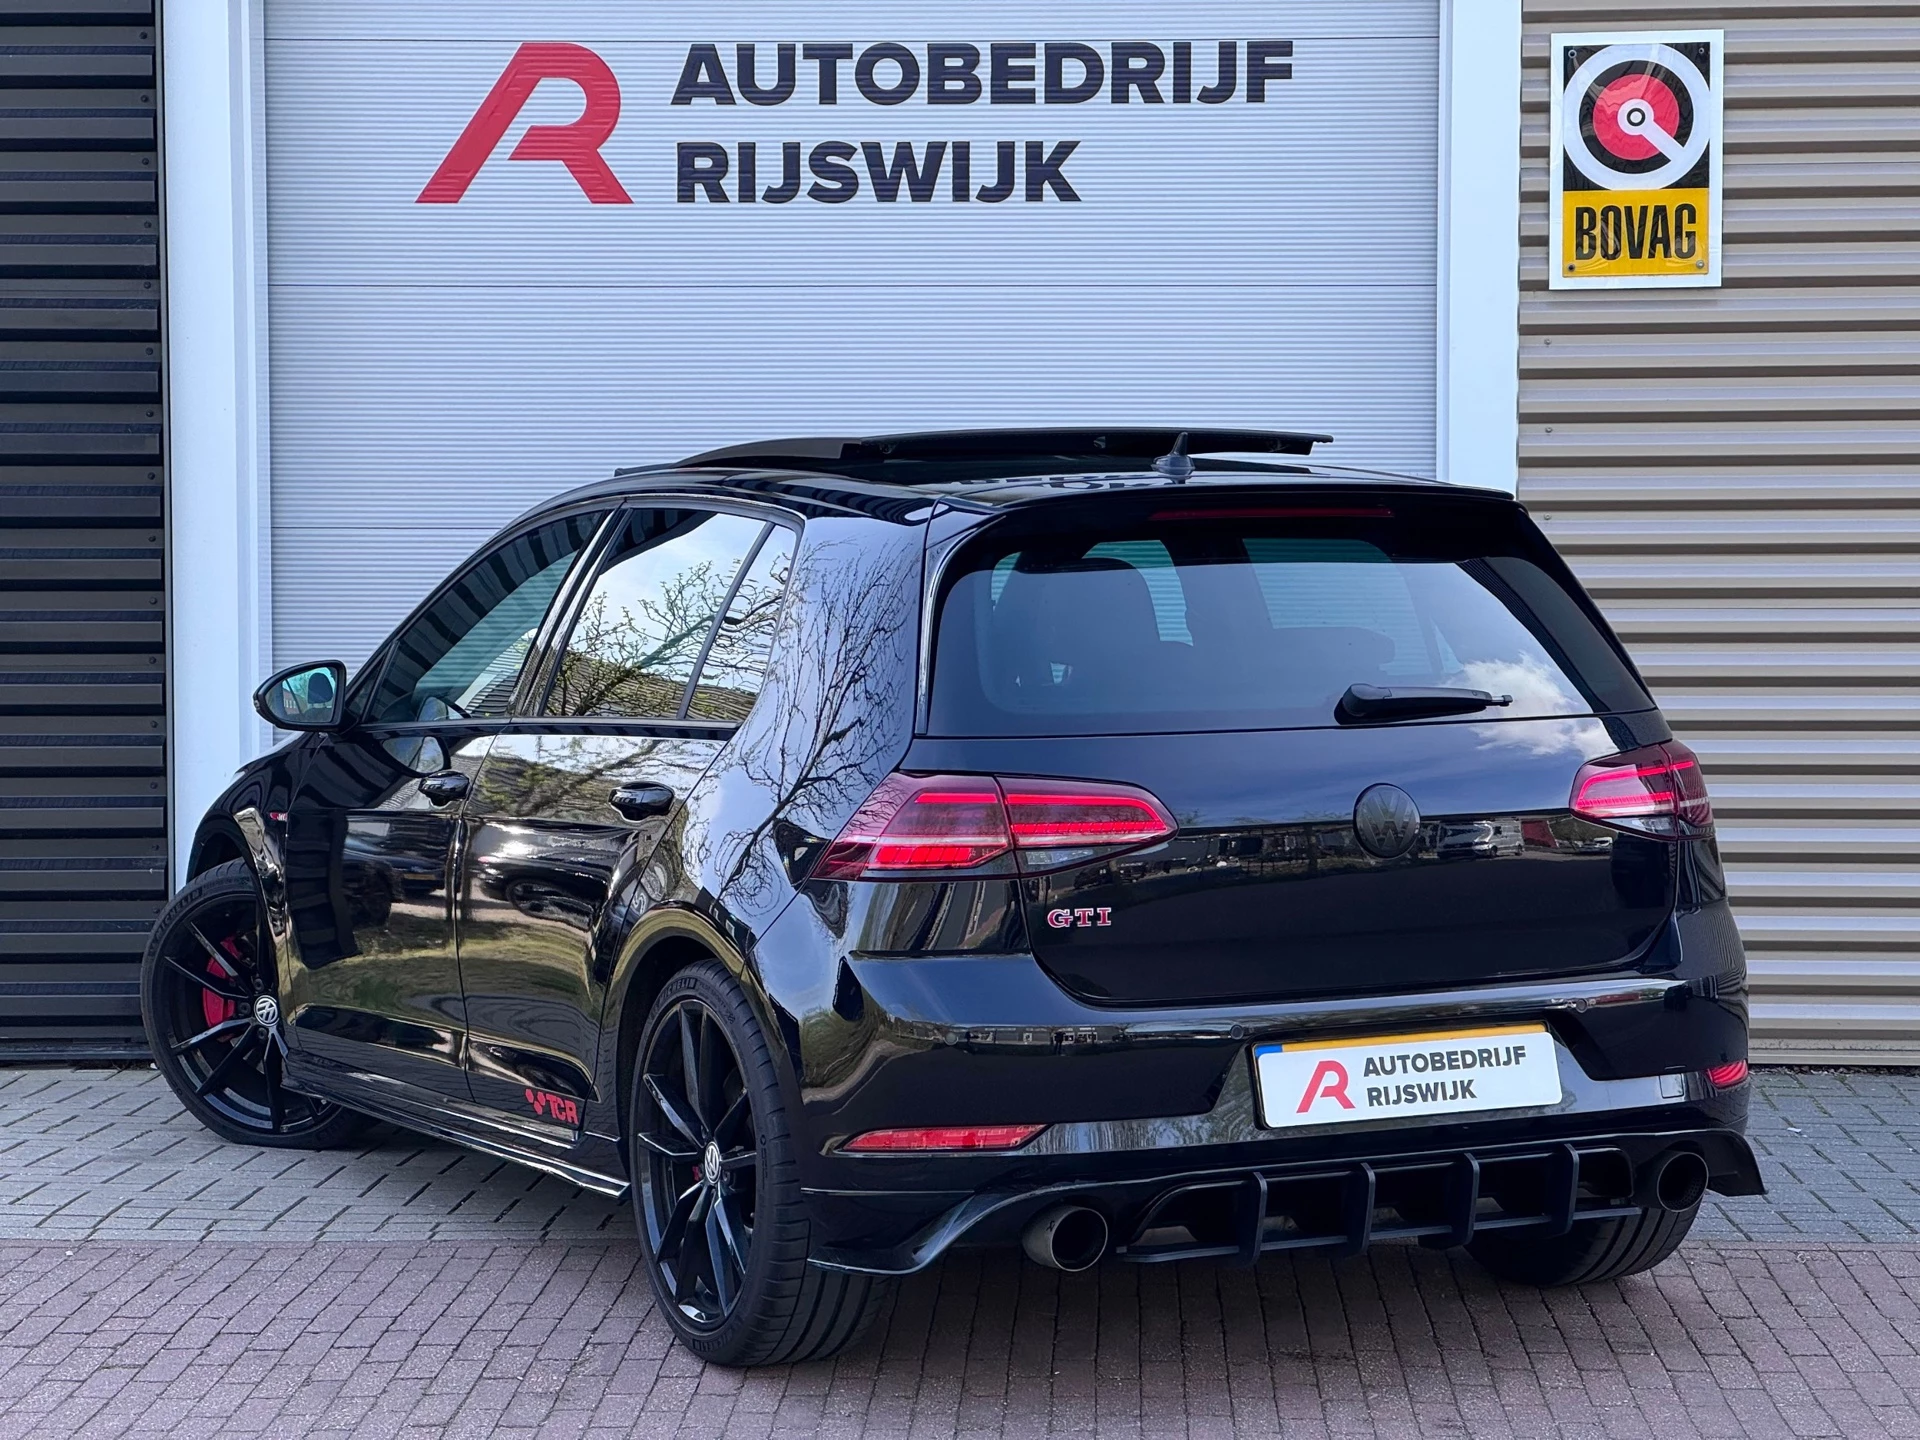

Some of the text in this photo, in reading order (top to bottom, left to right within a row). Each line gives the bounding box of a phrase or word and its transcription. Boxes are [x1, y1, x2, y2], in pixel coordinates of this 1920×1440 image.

[670, 40, 1294, 106] AUTOBEDRIJF
[676, 140, 1082, 204] RIJSWIJK
[1575, 203, 1697, 261] BOVAG
[1047, 907, 1112, 929] GTI
[1362, 1045, 1527, 1077] AUTOBEDRIJF
[545, 1093, 579, 1125] TCR
[1366, 1079, 1478, 1107] RIJSWIJK
